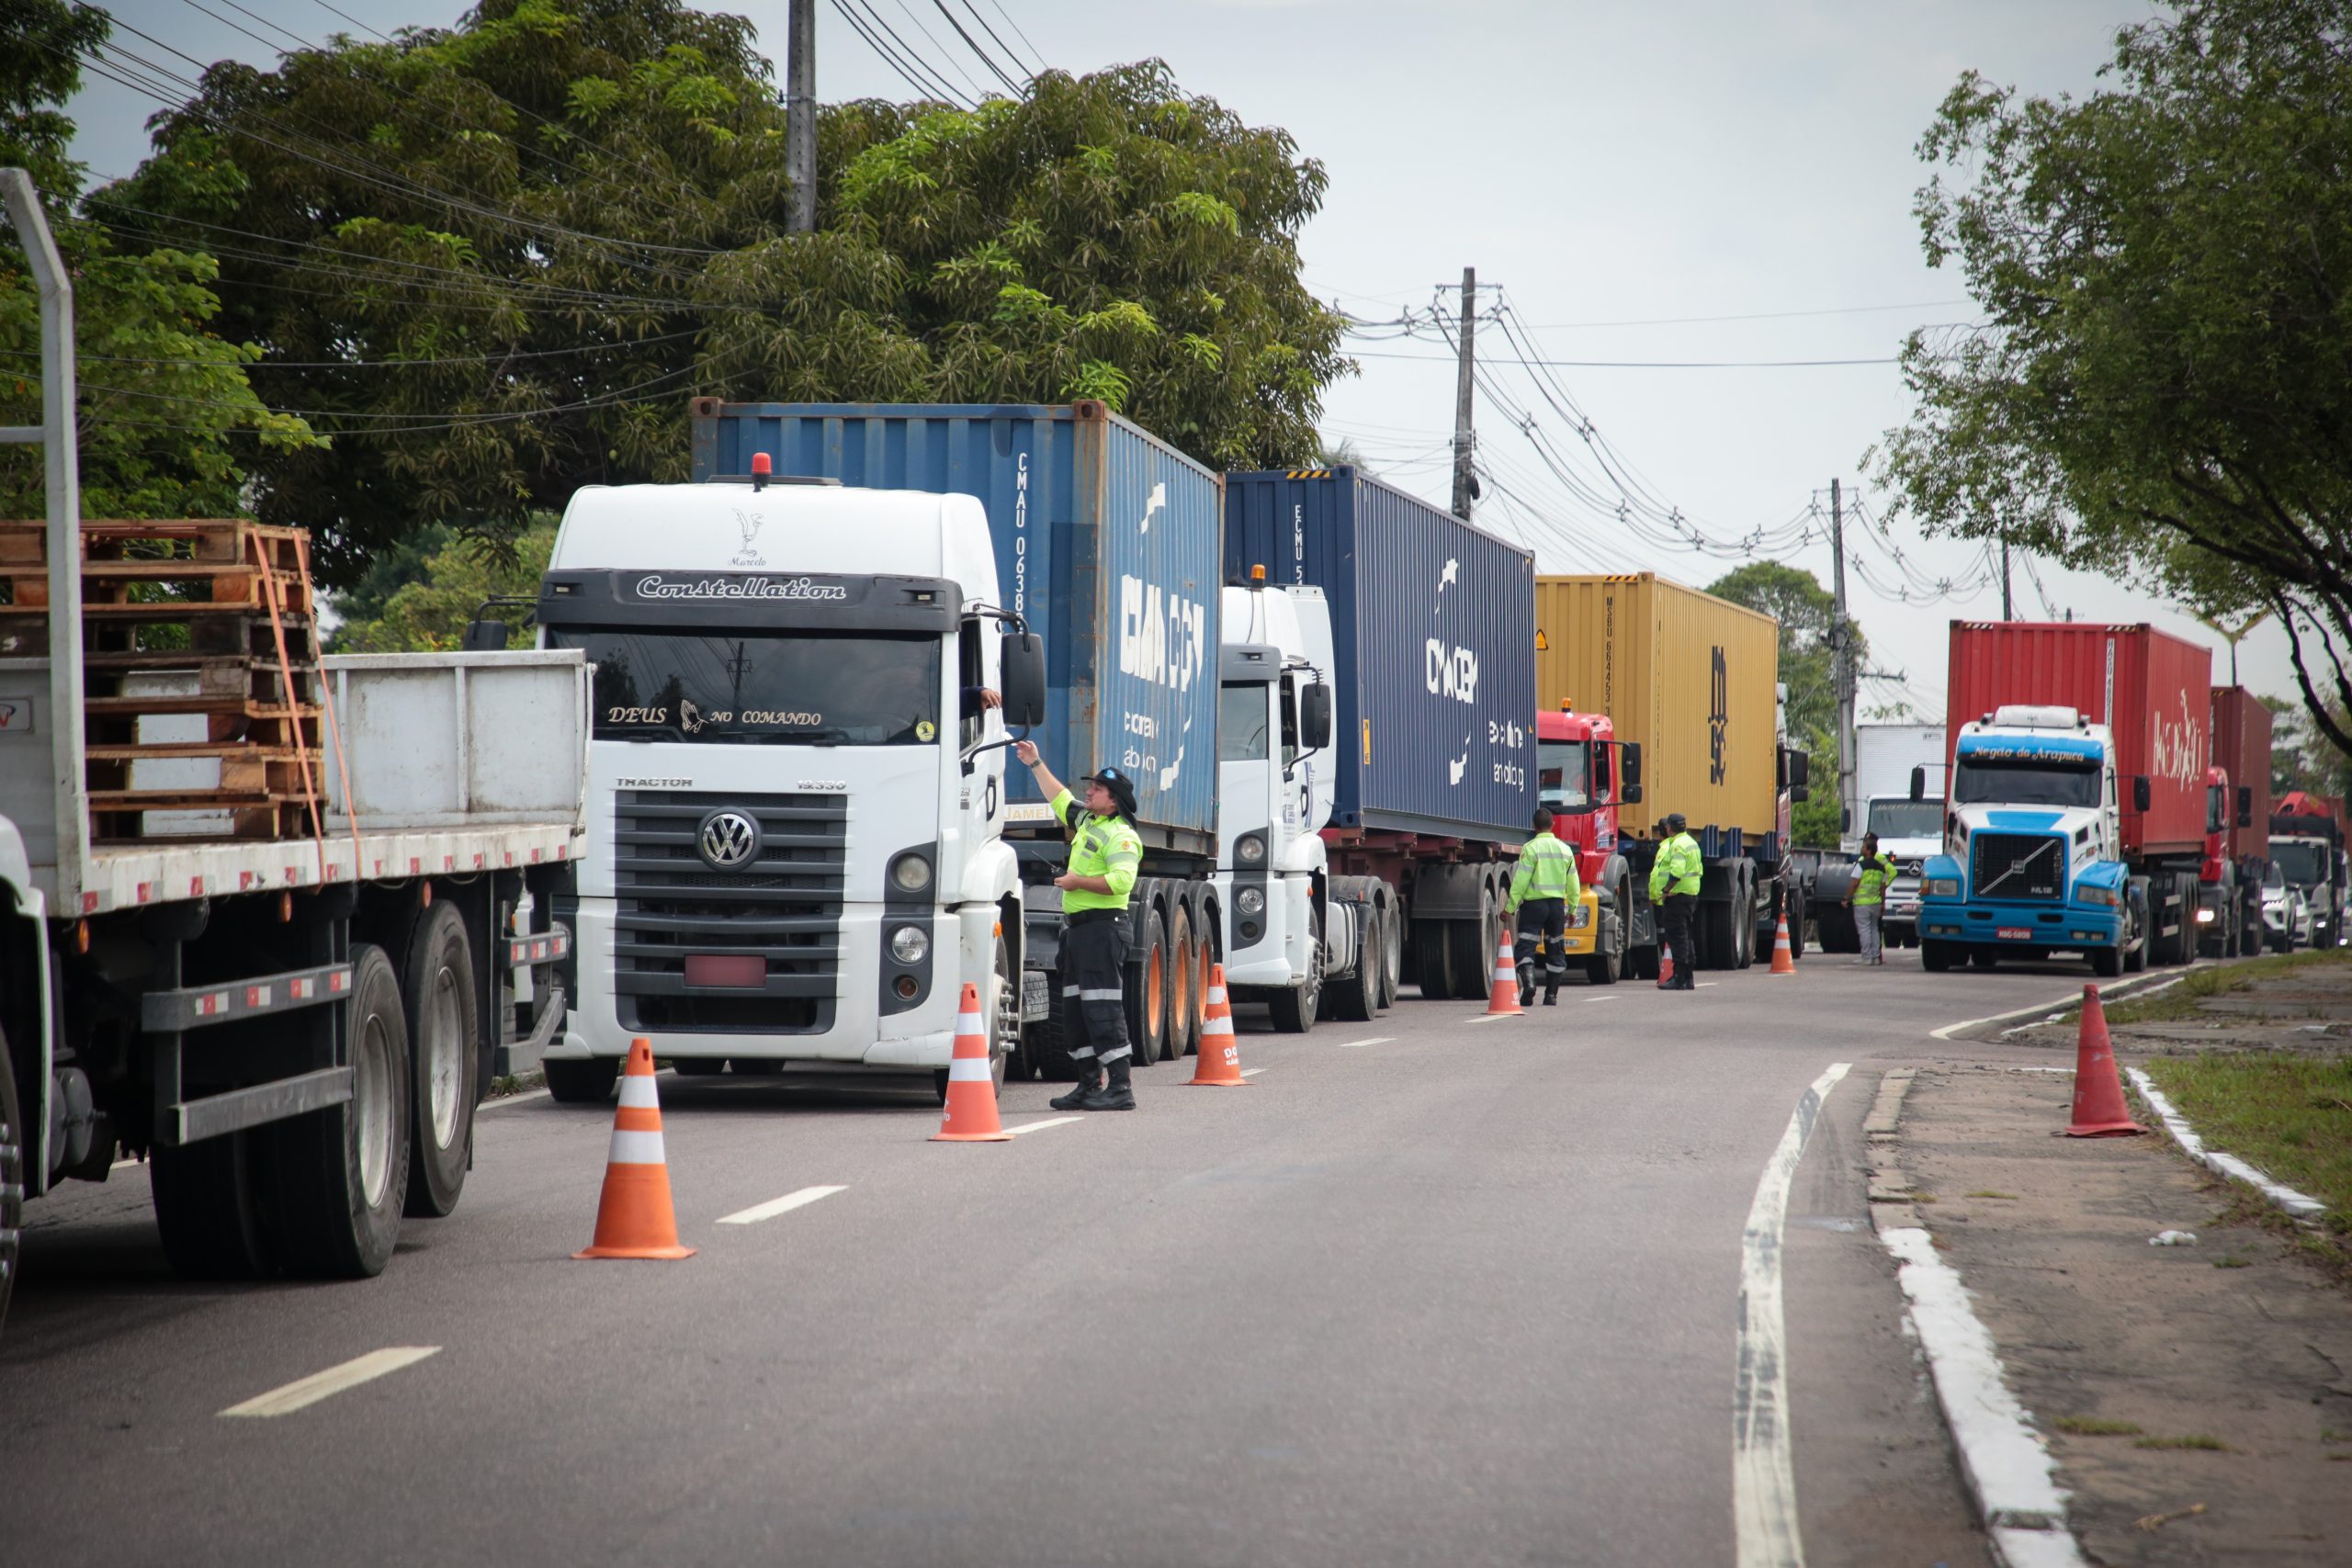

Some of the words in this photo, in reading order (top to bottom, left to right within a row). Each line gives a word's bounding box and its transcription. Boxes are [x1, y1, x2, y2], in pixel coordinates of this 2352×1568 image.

[1015, 452, 1028, 528] CMAU
[1295, 504, 1303, 560] ECMU
[727, 556, 768, 567] Marcelo
[1295, 565, 1303, 586] 5
[636, 575, 847, 600] Constellation
[608, 707, 667, 724] DEUS
[710, 711, 733, 722] NO
[741, 710, 821, 726] COMANDO
[2017, 746, 2030, 758] da
[2031, 747, 2085, 762] Arapuca
[616, 777, 693, 787] TRACTOR
